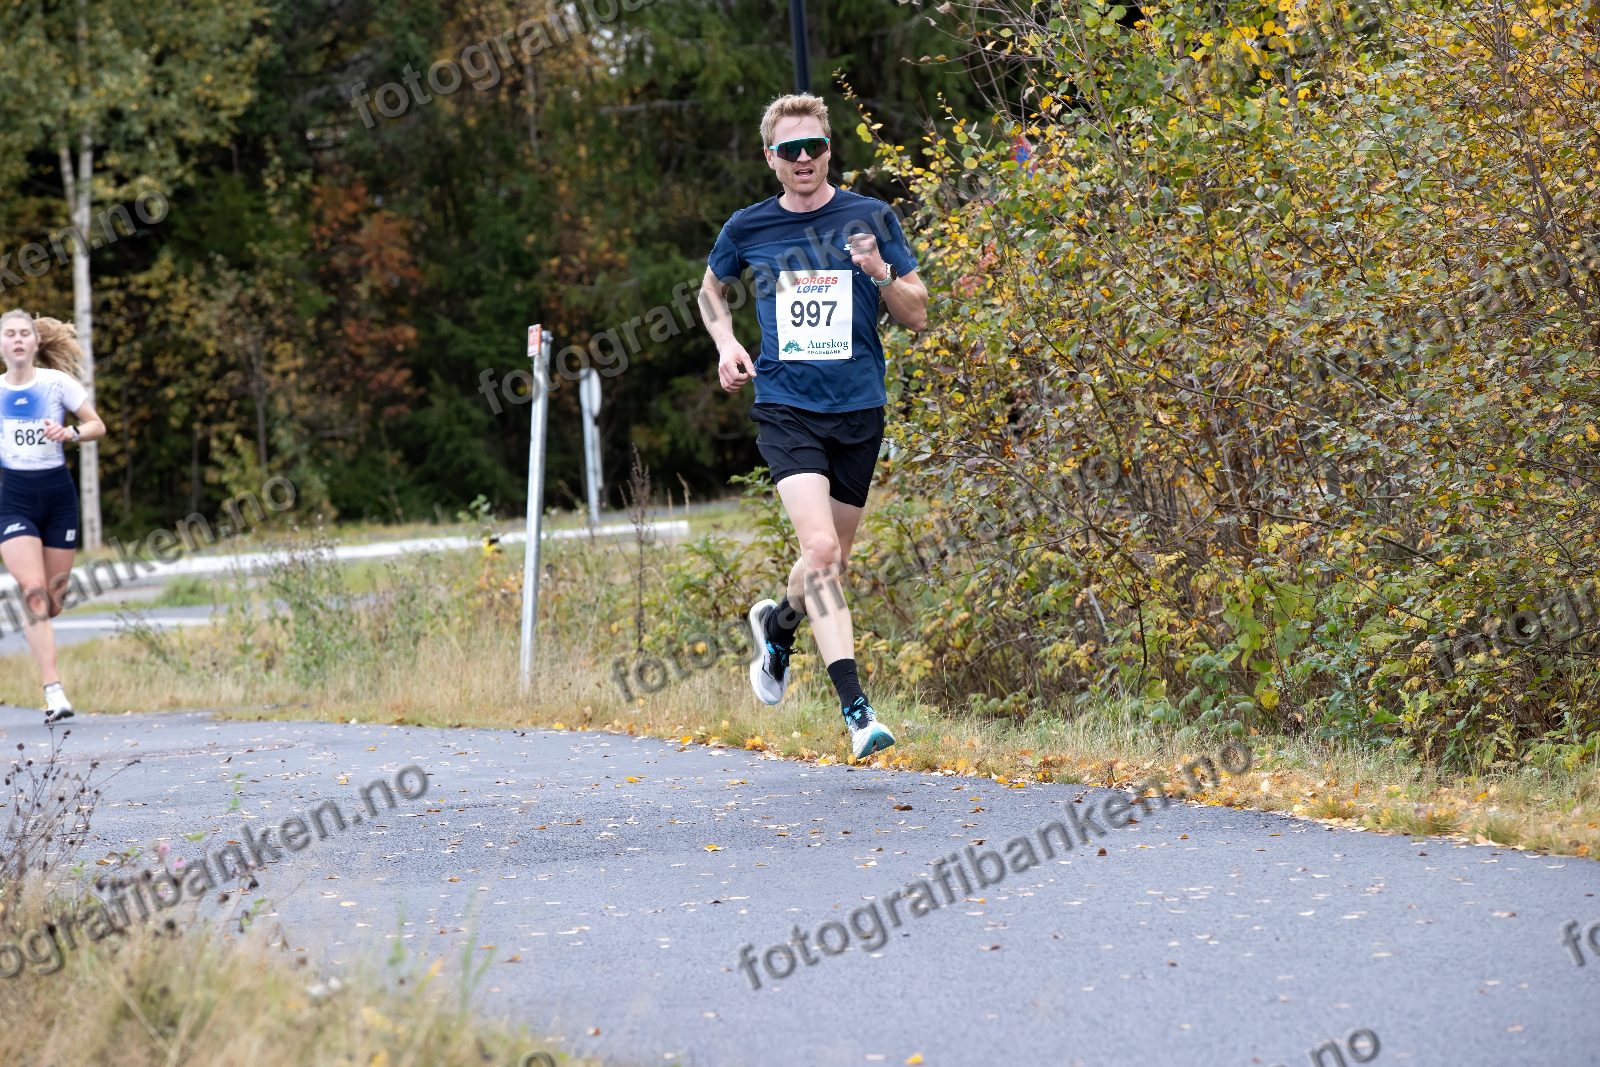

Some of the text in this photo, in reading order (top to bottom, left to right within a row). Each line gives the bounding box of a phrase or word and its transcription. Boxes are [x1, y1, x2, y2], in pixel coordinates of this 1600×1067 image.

[794, 277, 838, 285] NORGES
[797, 285, 831, 293] LØPET
[790, 300, 838, 327] 997
[807, 339, 849, 350] Aurskog
[15, 428, 47, 446] 682
